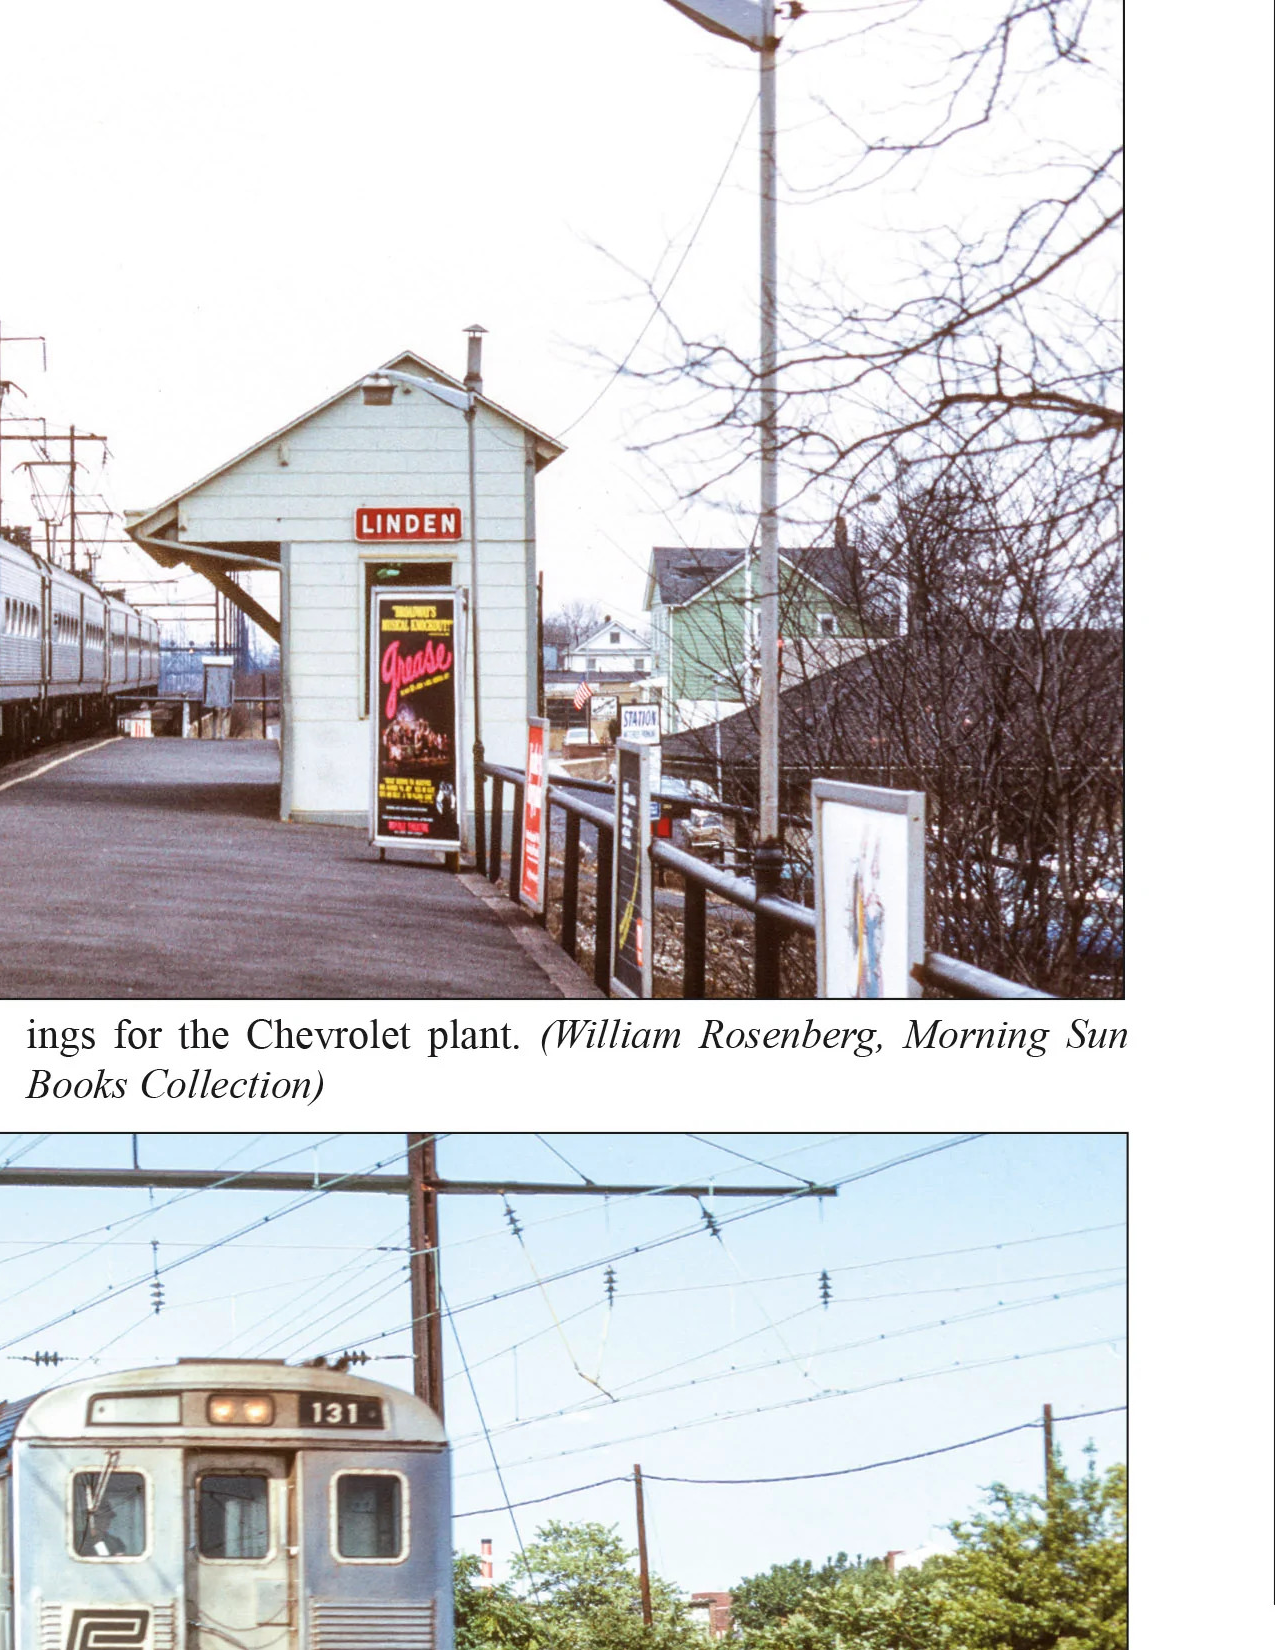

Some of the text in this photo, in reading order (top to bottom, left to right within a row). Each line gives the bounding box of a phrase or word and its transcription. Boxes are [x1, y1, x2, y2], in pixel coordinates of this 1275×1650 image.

[362, 513, 455, 534] LINDEN
[623, 710, 657, 728] STATION
[27, 1019, 1127, 1057] ings for the Chevrolet plant. (William Rosenberg, Morning Sun
[25, 1069, 323, 1106] Books Collection)
[312, 1402, 358, 1424] 131
